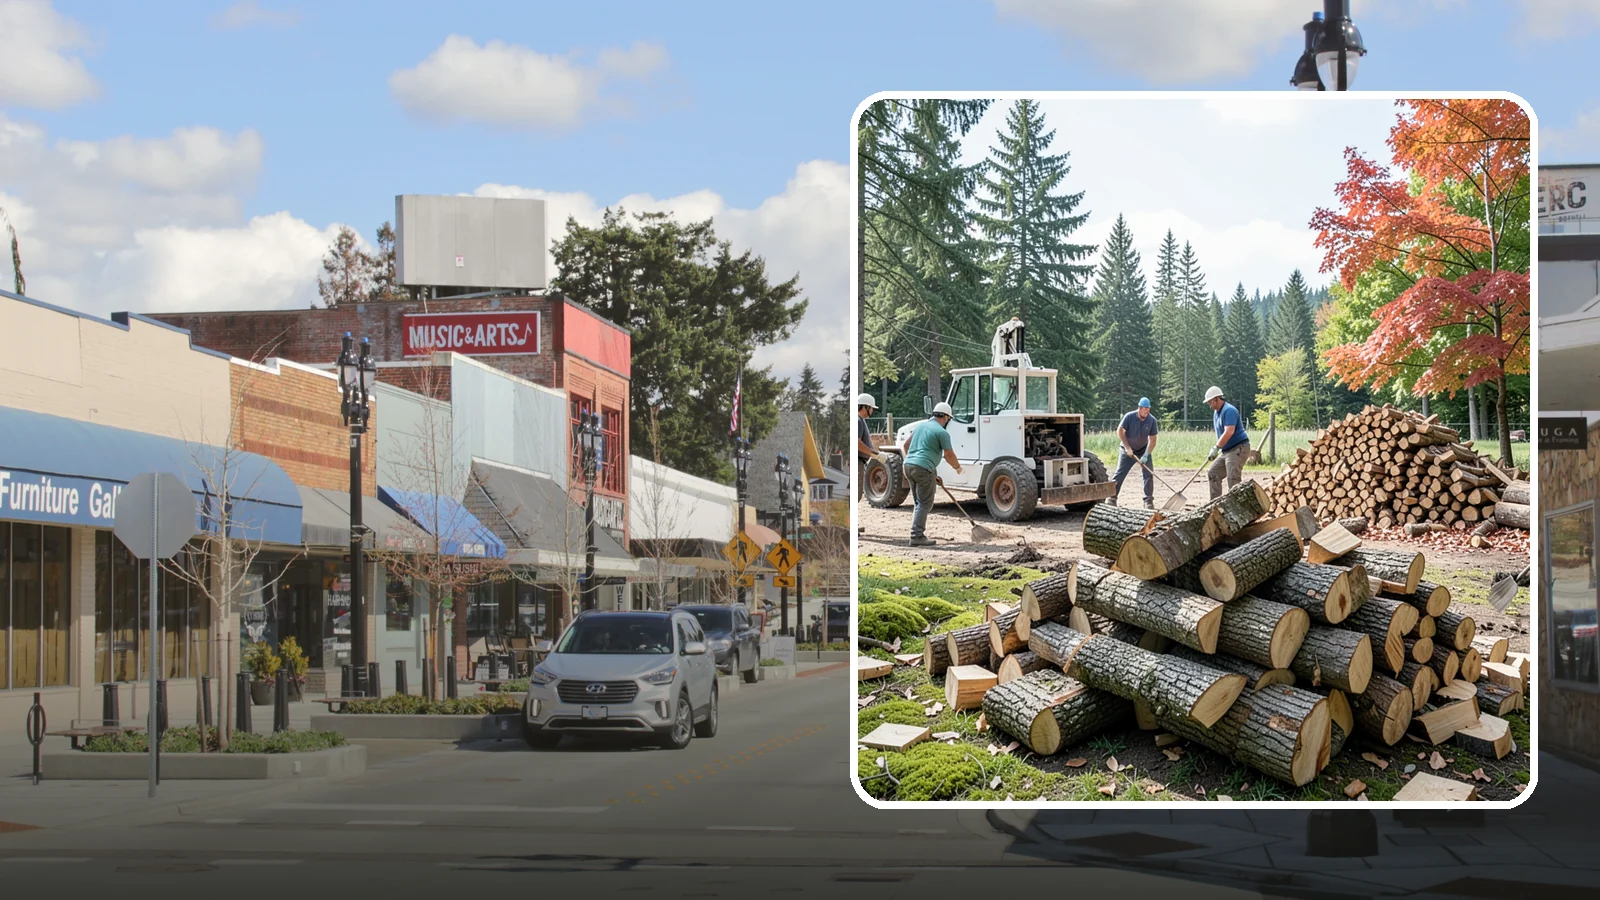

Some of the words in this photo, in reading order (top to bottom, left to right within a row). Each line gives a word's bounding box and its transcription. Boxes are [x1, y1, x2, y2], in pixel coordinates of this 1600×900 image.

[409, 322, 520, 349] MUSIC&ARTS
[1551, 436, 1579, 445] Framing
[0, 471, 79, 515] Furniture
[89, 482, 122, 519] Gal
[453, 563, 479, 574] SUSHI
